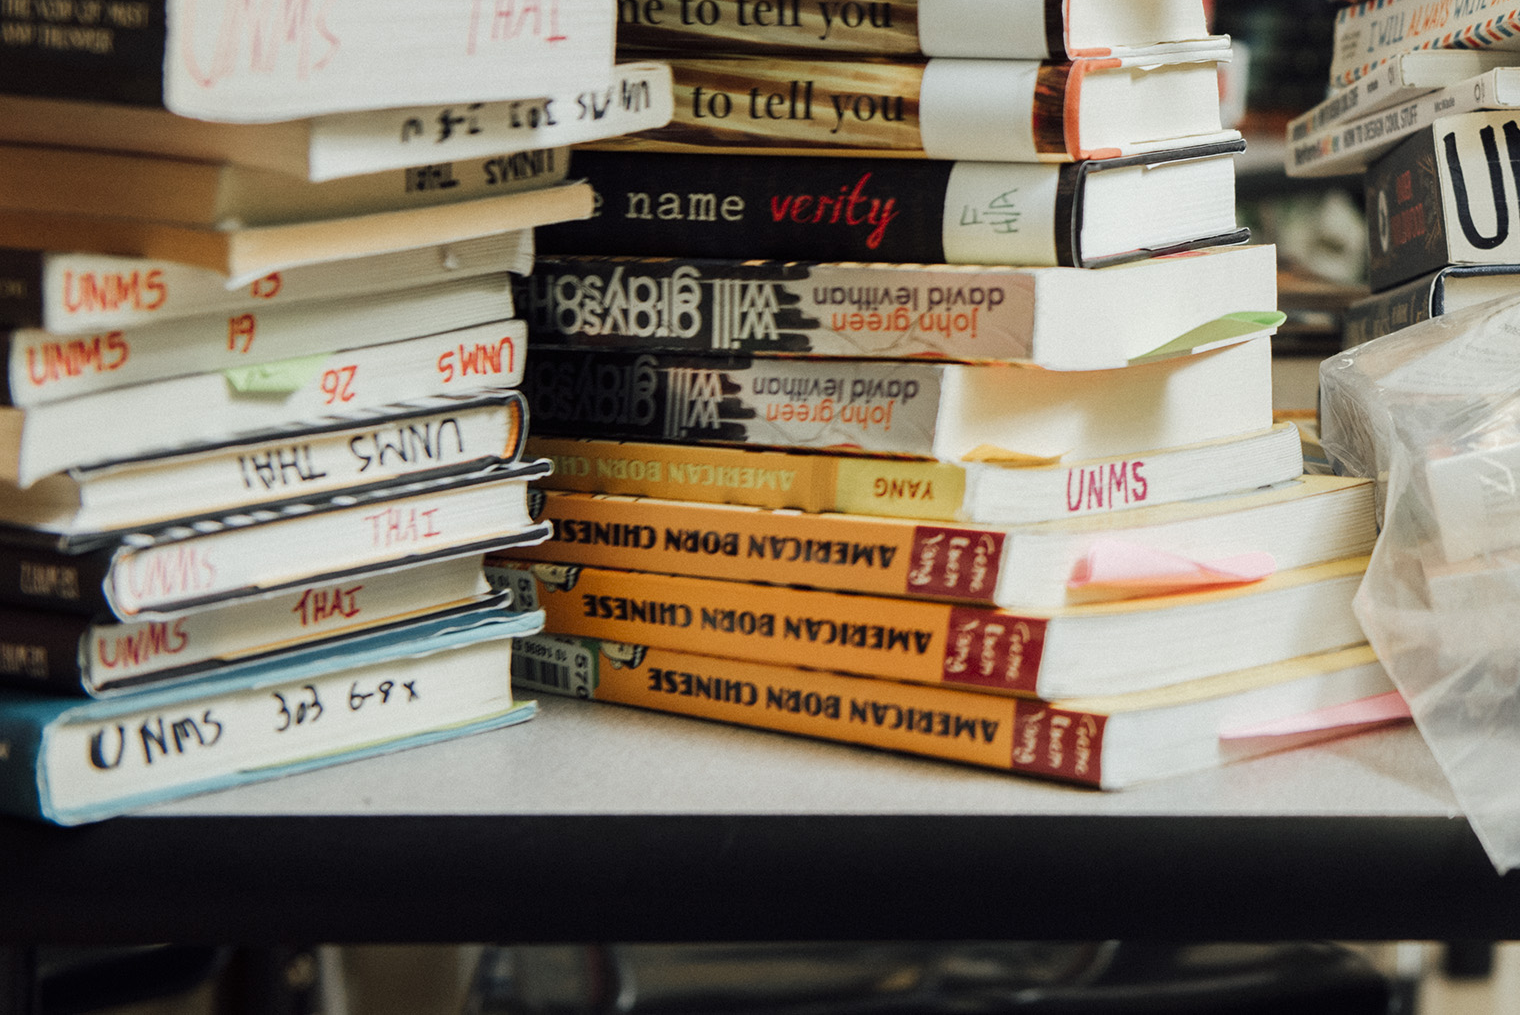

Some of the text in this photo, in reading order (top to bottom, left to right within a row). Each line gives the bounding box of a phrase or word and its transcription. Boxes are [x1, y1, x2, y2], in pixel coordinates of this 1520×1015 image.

[692, 80, 906, 135] to tell you
[625, 173, 900, 250] name verity
[62, 270, 168, 314] UNMS
[812, 285, 1006, 312] david levithan
[831, 309, 979, 339] john green
[26, 329, 131, 387] UNMS
[437, 336, 516, 383] UNMS
[751, 376, 920, 400] david levithan
[765, 401, 893, 426] john green
[236, 417, 466, 487] UNMS THAI
[598, 456, 662, 483] BORN
[667, 460, 797, 492] AMERICAN
[873, 477, 935, 501] YANG
[1065, 459, 1150, 512] UNMS
[664, 527, 741, 557] BORN
[747, 534, 898, 570] AMERICAN
[97, 614, 190, 669] UNMS
[293, 585, 364, 627] THAI
[582, 592, 934, 657] AMERICAN BORN CHINESE
[647, 666, 999, 745] AMERICAN BORN CHINESE
